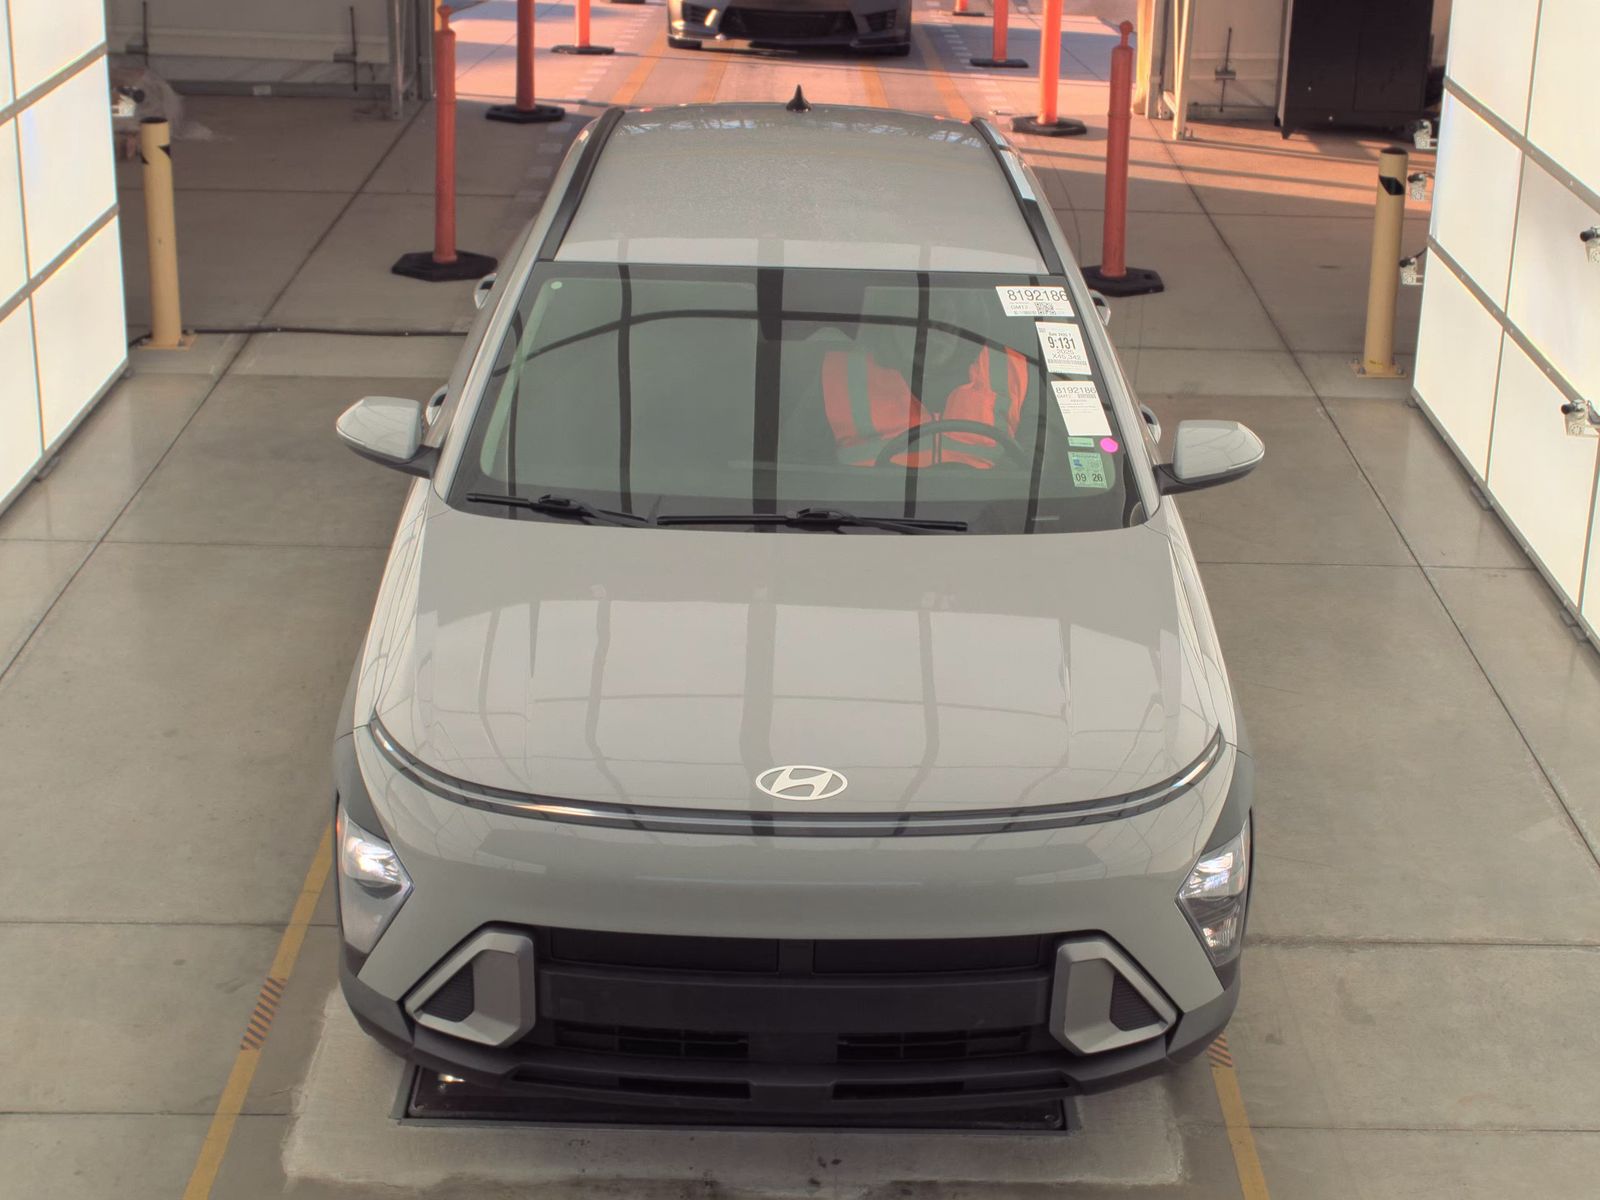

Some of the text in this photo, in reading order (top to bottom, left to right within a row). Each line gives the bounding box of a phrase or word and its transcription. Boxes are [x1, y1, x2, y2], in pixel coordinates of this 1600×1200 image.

[1007, 289, 1068, 301] 8192186
[1047, 336, 1076, 350] 9:131
[1075, 473, 1103, 483] 09 26
